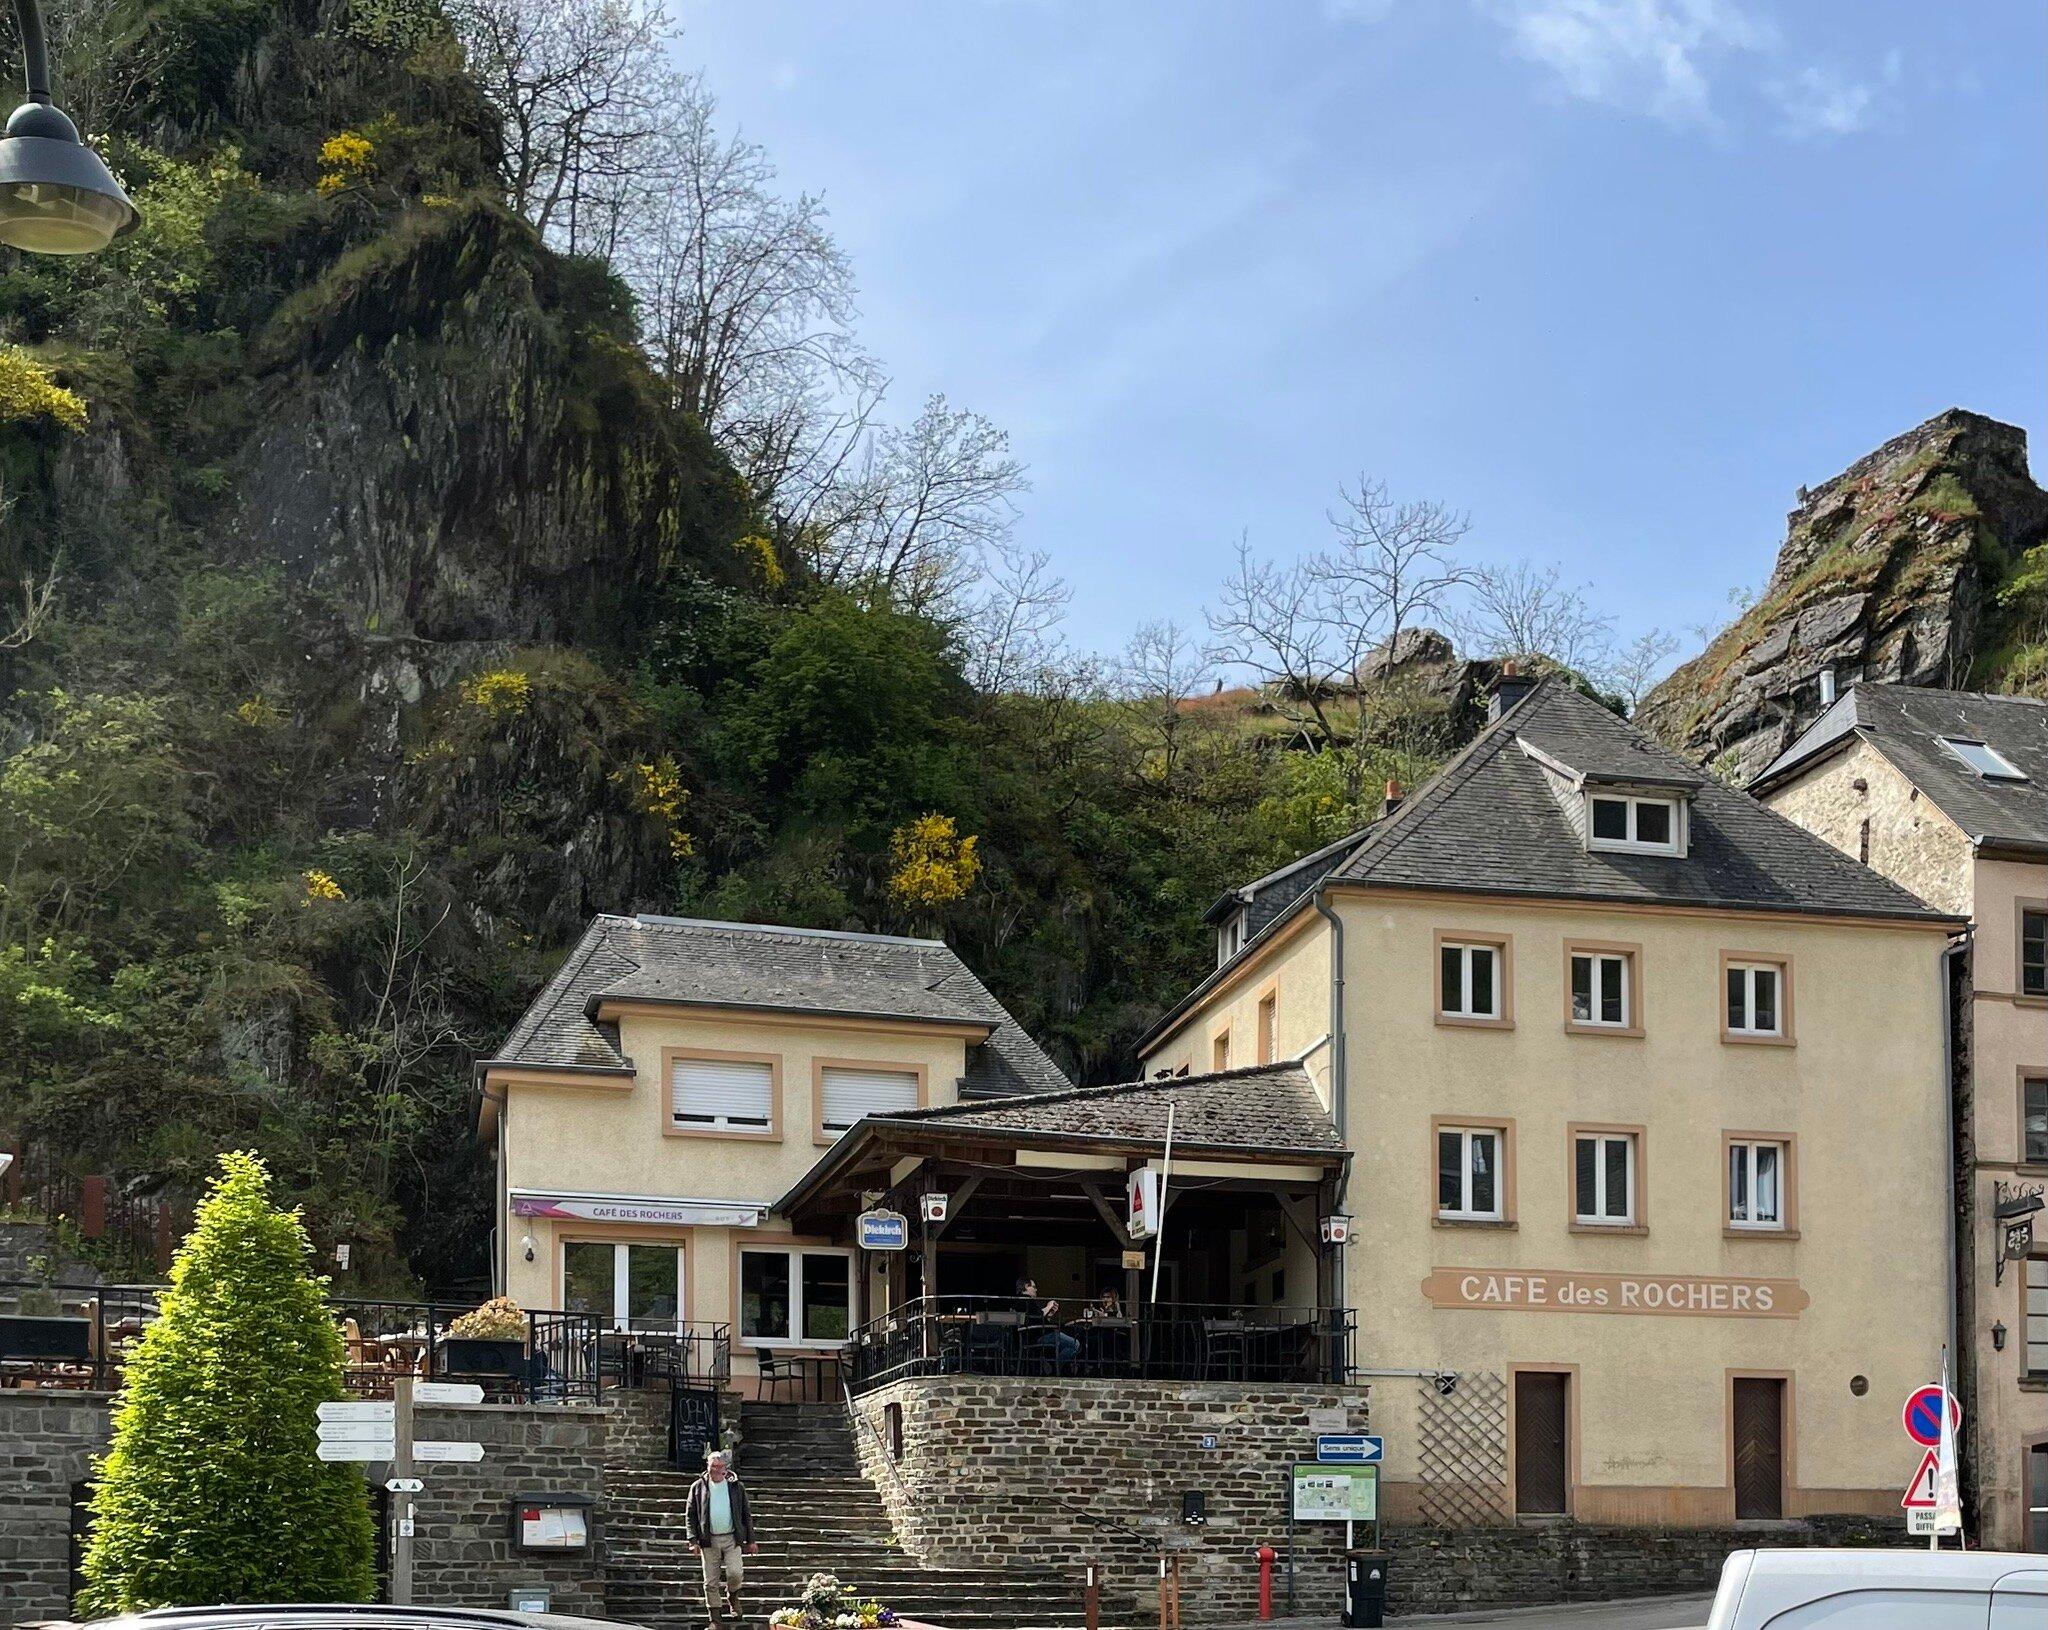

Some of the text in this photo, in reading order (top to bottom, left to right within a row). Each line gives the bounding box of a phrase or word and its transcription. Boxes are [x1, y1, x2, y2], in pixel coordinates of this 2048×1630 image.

[593, 1208, 683, 1220] CAFÉ DES ROCHERS
[864, 1223, 902, 1235] Diekirch
[1460, 1275, 1774, 1311] CAFE des ROCHERS
[1342, 1445, 1366, 1453] unique
